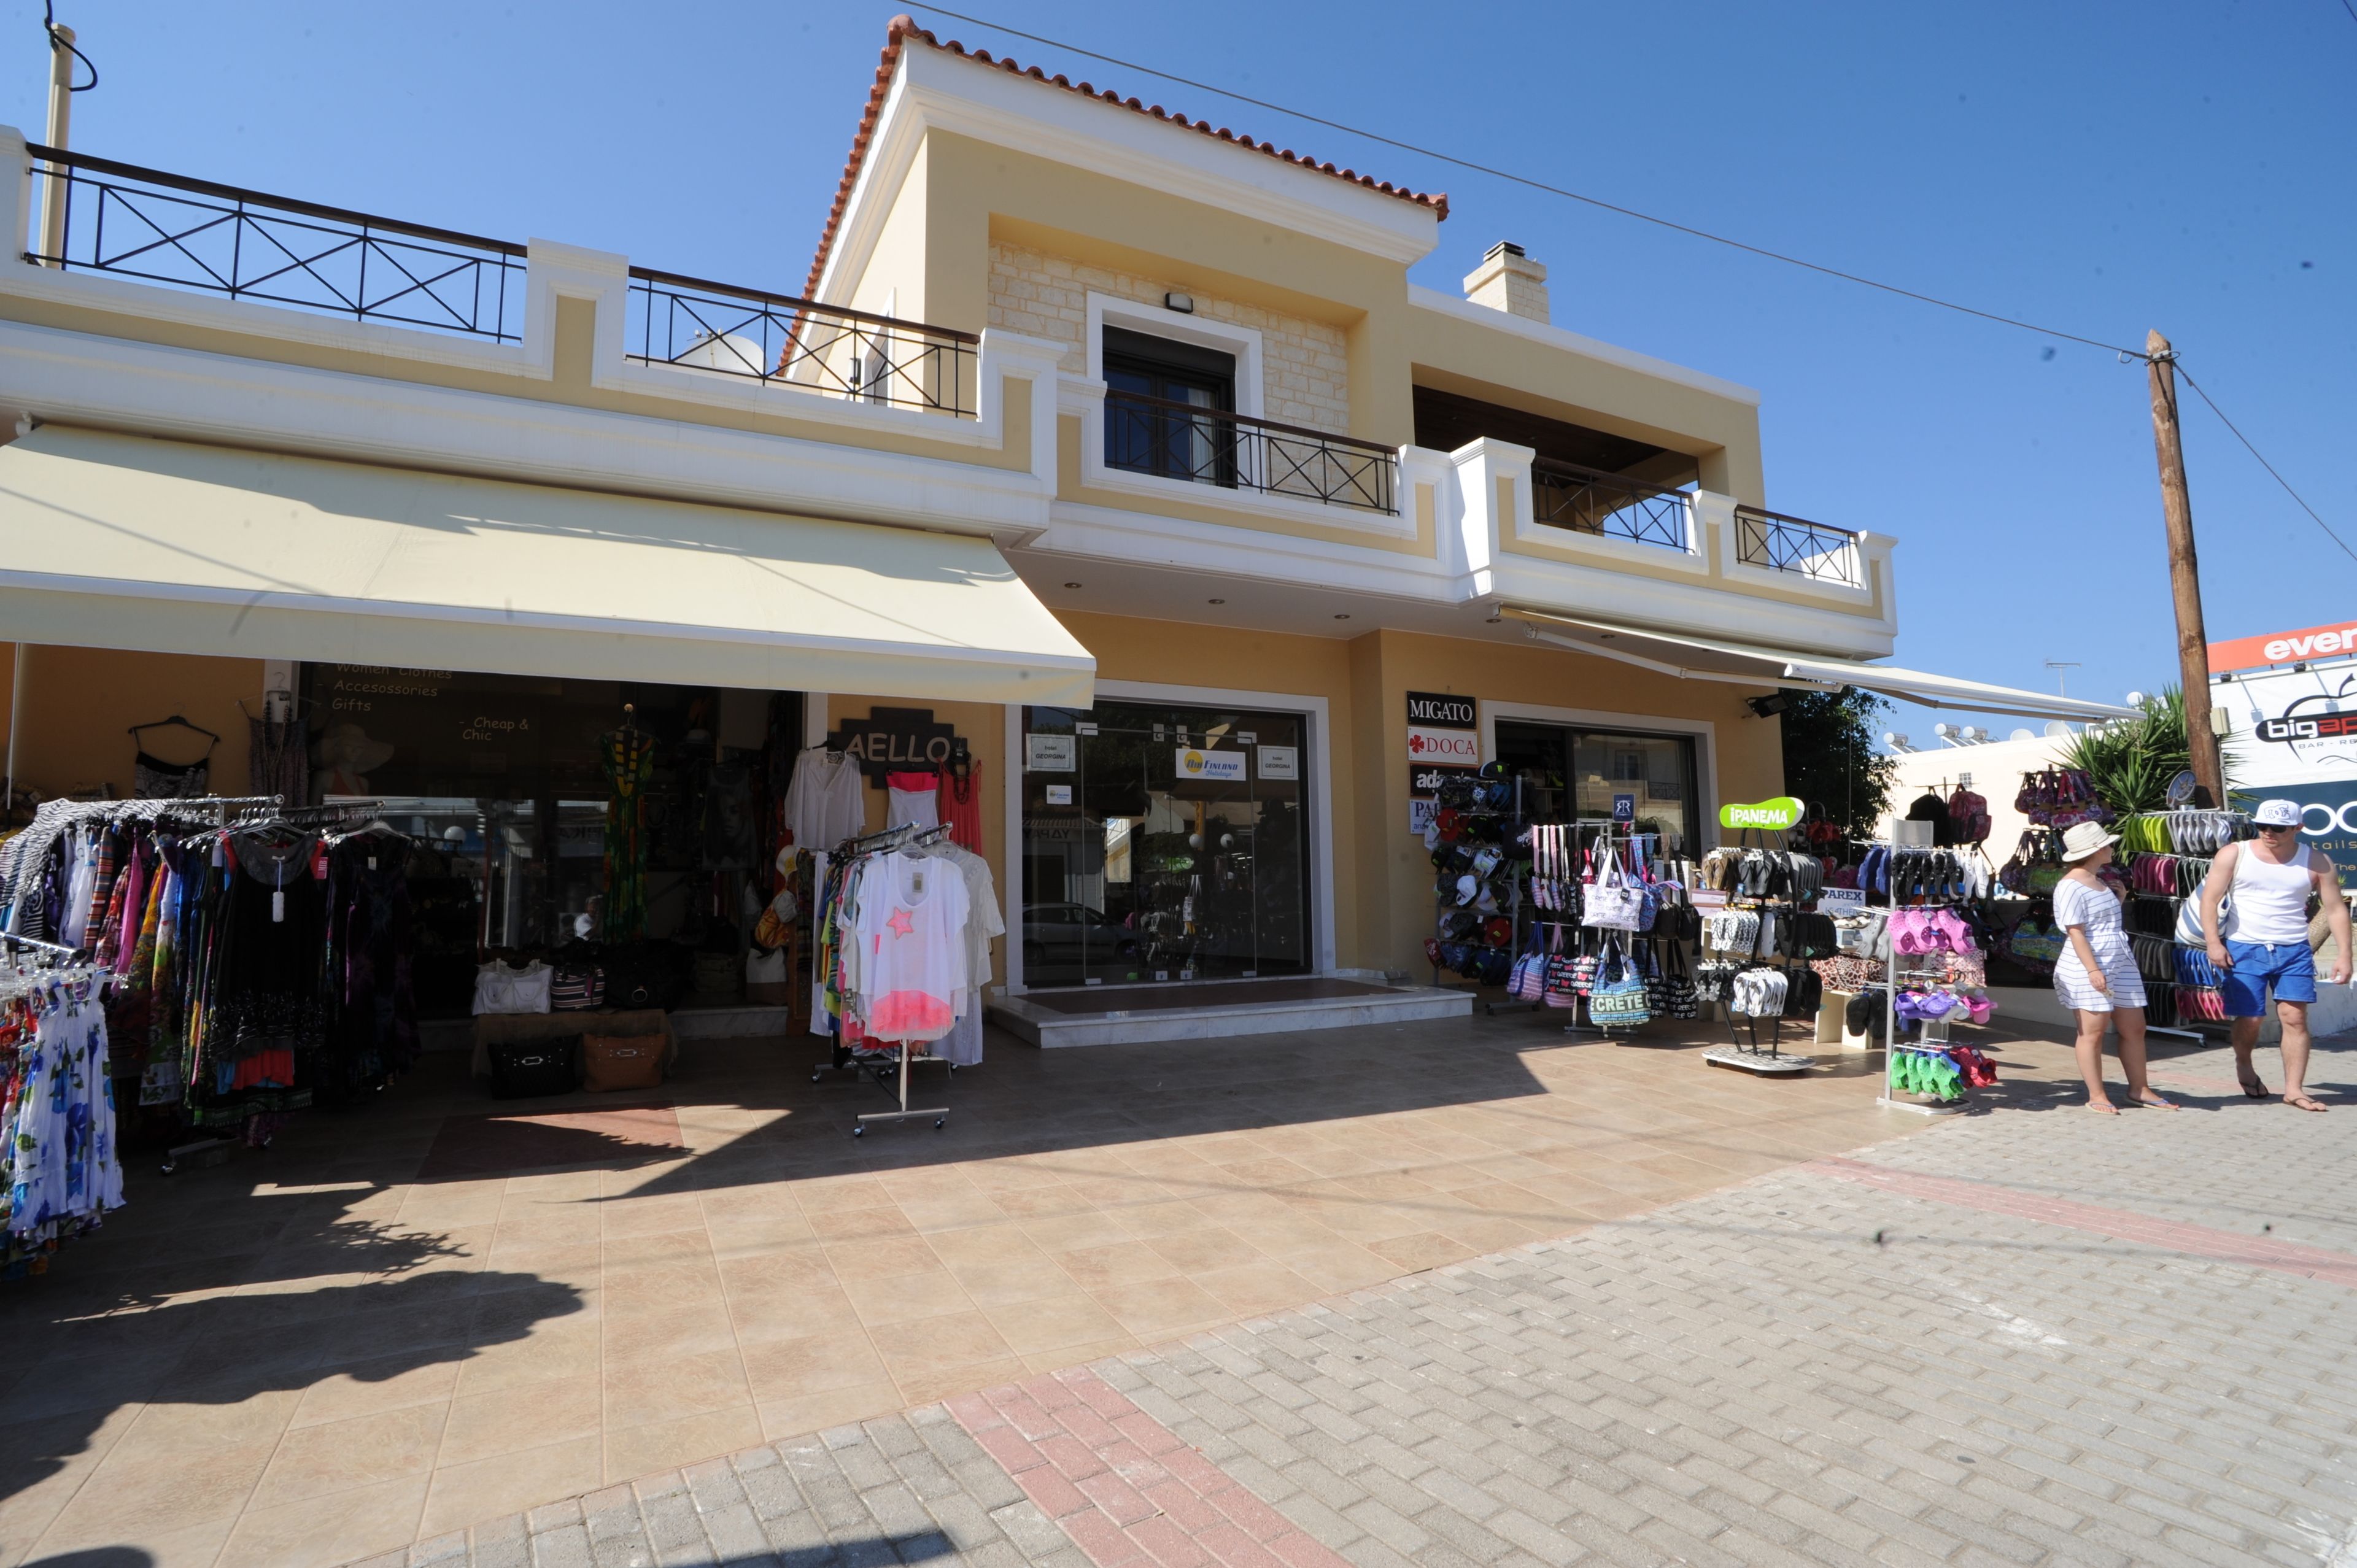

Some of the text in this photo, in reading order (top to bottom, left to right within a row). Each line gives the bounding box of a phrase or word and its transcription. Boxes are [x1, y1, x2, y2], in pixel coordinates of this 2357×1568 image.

[334, 679, 438, 697] Accesossories
[332, 698, 371, 711] Gifts
[1410, 700, 1473, 722] MIGATO
[474, 717, 528, 732] Cheap &
[463, 729, 492, 741] Chic
[847, 733, 950, 763] AELLO
[1427, 738, 1476, 755] DOCA
[1825, 890, 1863, 901] AREX
[1596, 994, 1644, 1011] CRETE
